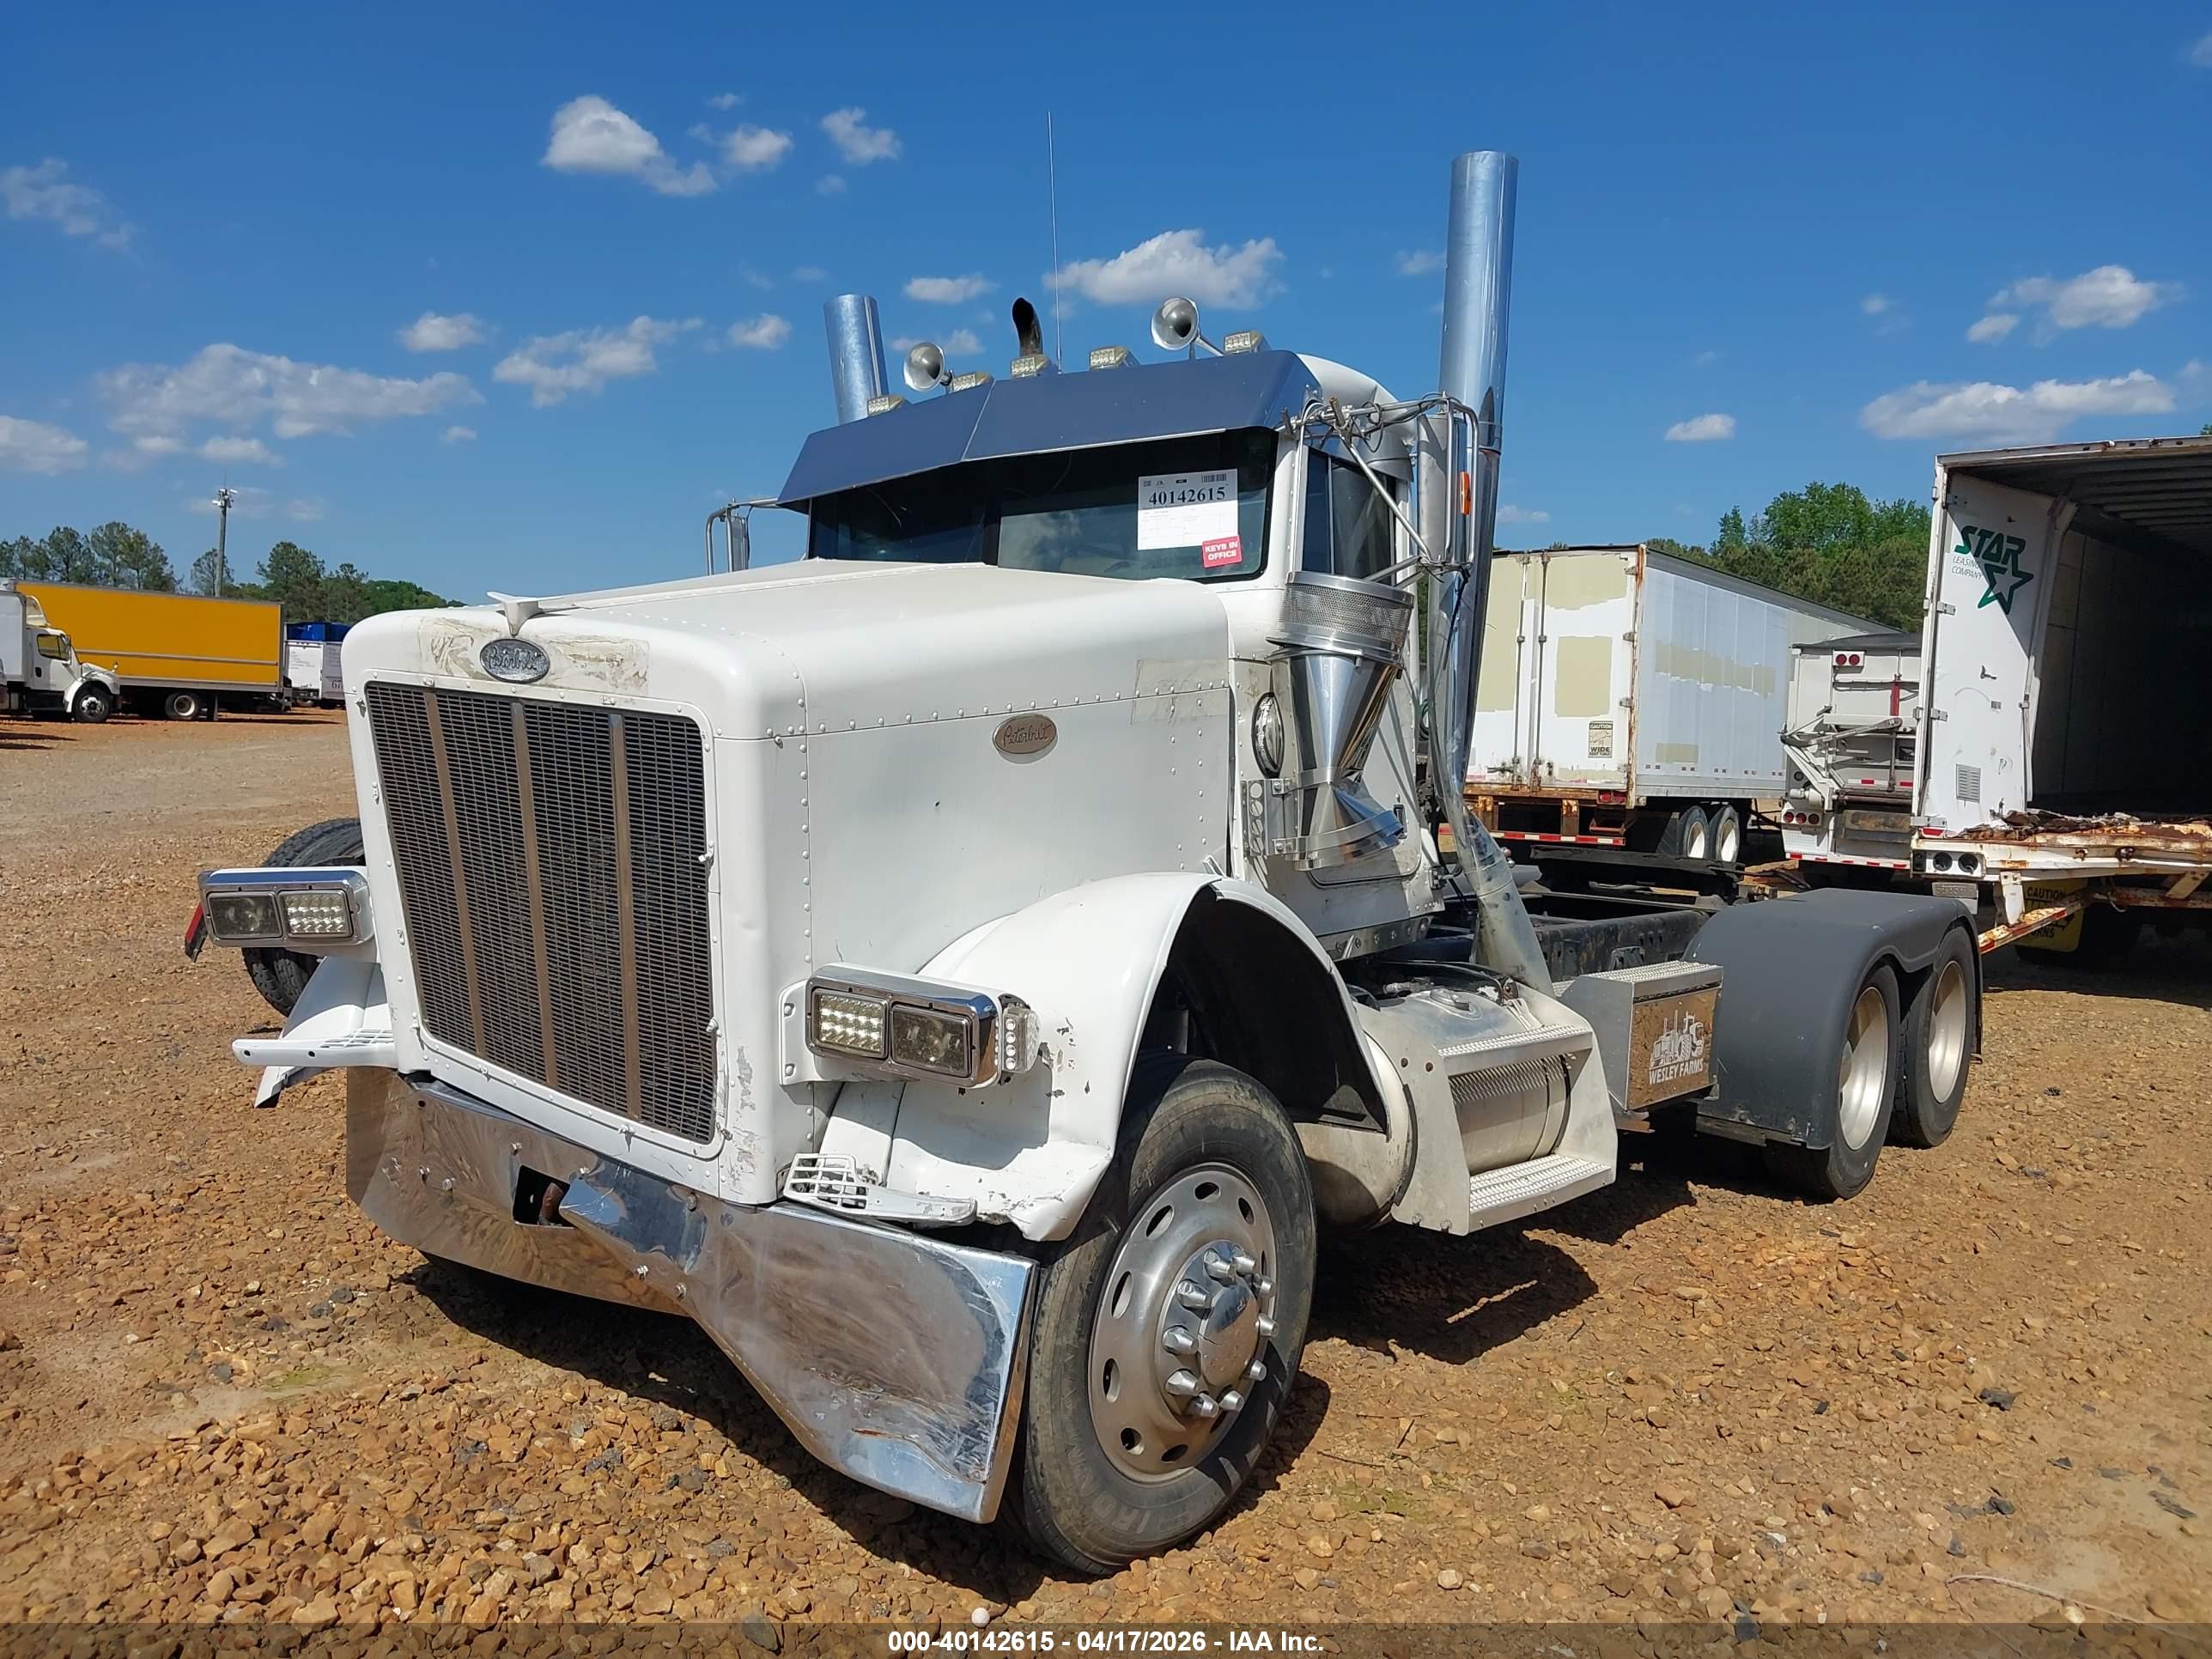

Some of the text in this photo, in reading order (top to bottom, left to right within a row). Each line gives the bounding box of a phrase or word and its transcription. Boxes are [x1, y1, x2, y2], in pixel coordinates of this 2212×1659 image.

[1149, 486, 1226, 505] 40142615
[1206, 544, 1226, 552] KEYS
[1954, 526, 2027, 565] STAR
[1208, 550, 1237, 560] OFFICE
[1953, 556, 1979, 568] LEASING
[1952, 566, 1982, 580] COMPANY
[1649, 1057, 1704, 1085] WESLEY FARMS
